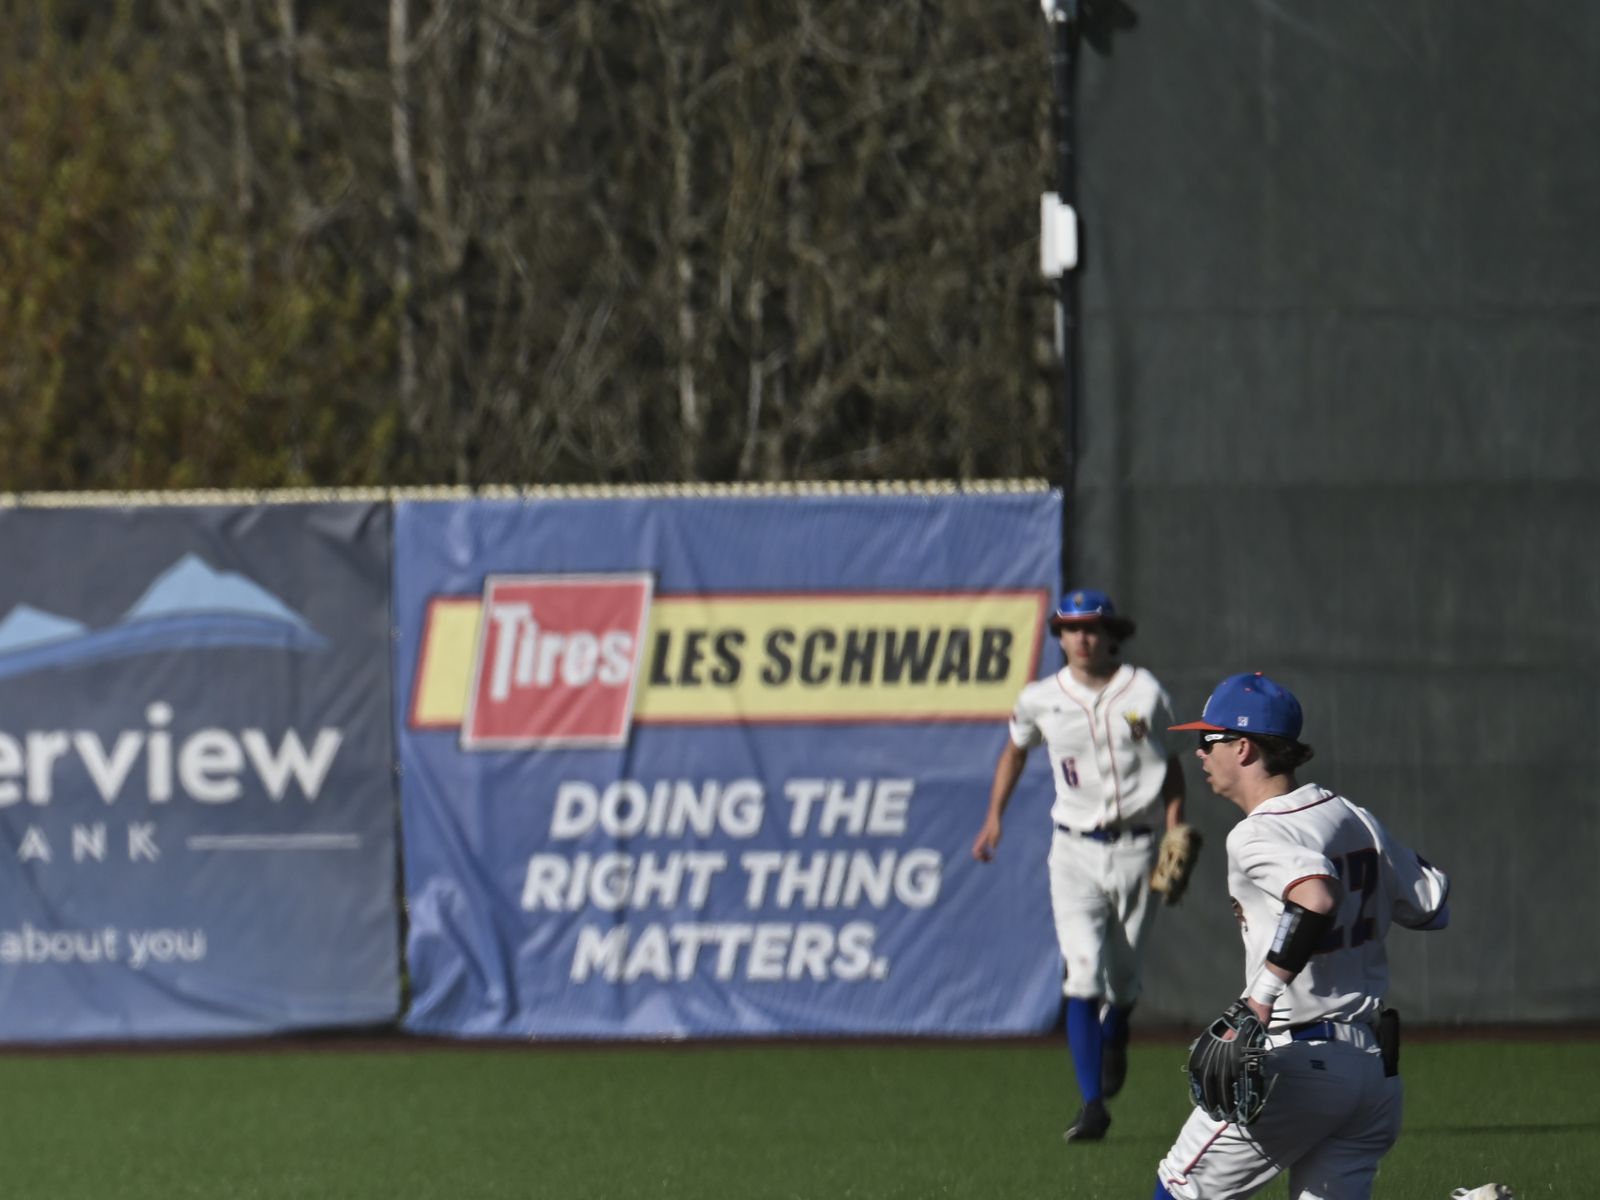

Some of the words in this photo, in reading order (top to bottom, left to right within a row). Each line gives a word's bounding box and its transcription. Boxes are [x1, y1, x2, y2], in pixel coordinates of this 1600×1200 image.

[491, 603, 635, 701] Tires
[648, 628, 746, 687] LES
[761, 627, 1015, 687] SCHWAB
[550, 780, 767, 840] DOING
[784, 778, 915, 838] THE
[521, 851, 726, 912] RIGHT
[740, 848, 943, 910] THING
[128, 930, 208, 970] you
[570, 922, 889, 984] MATTERS.
